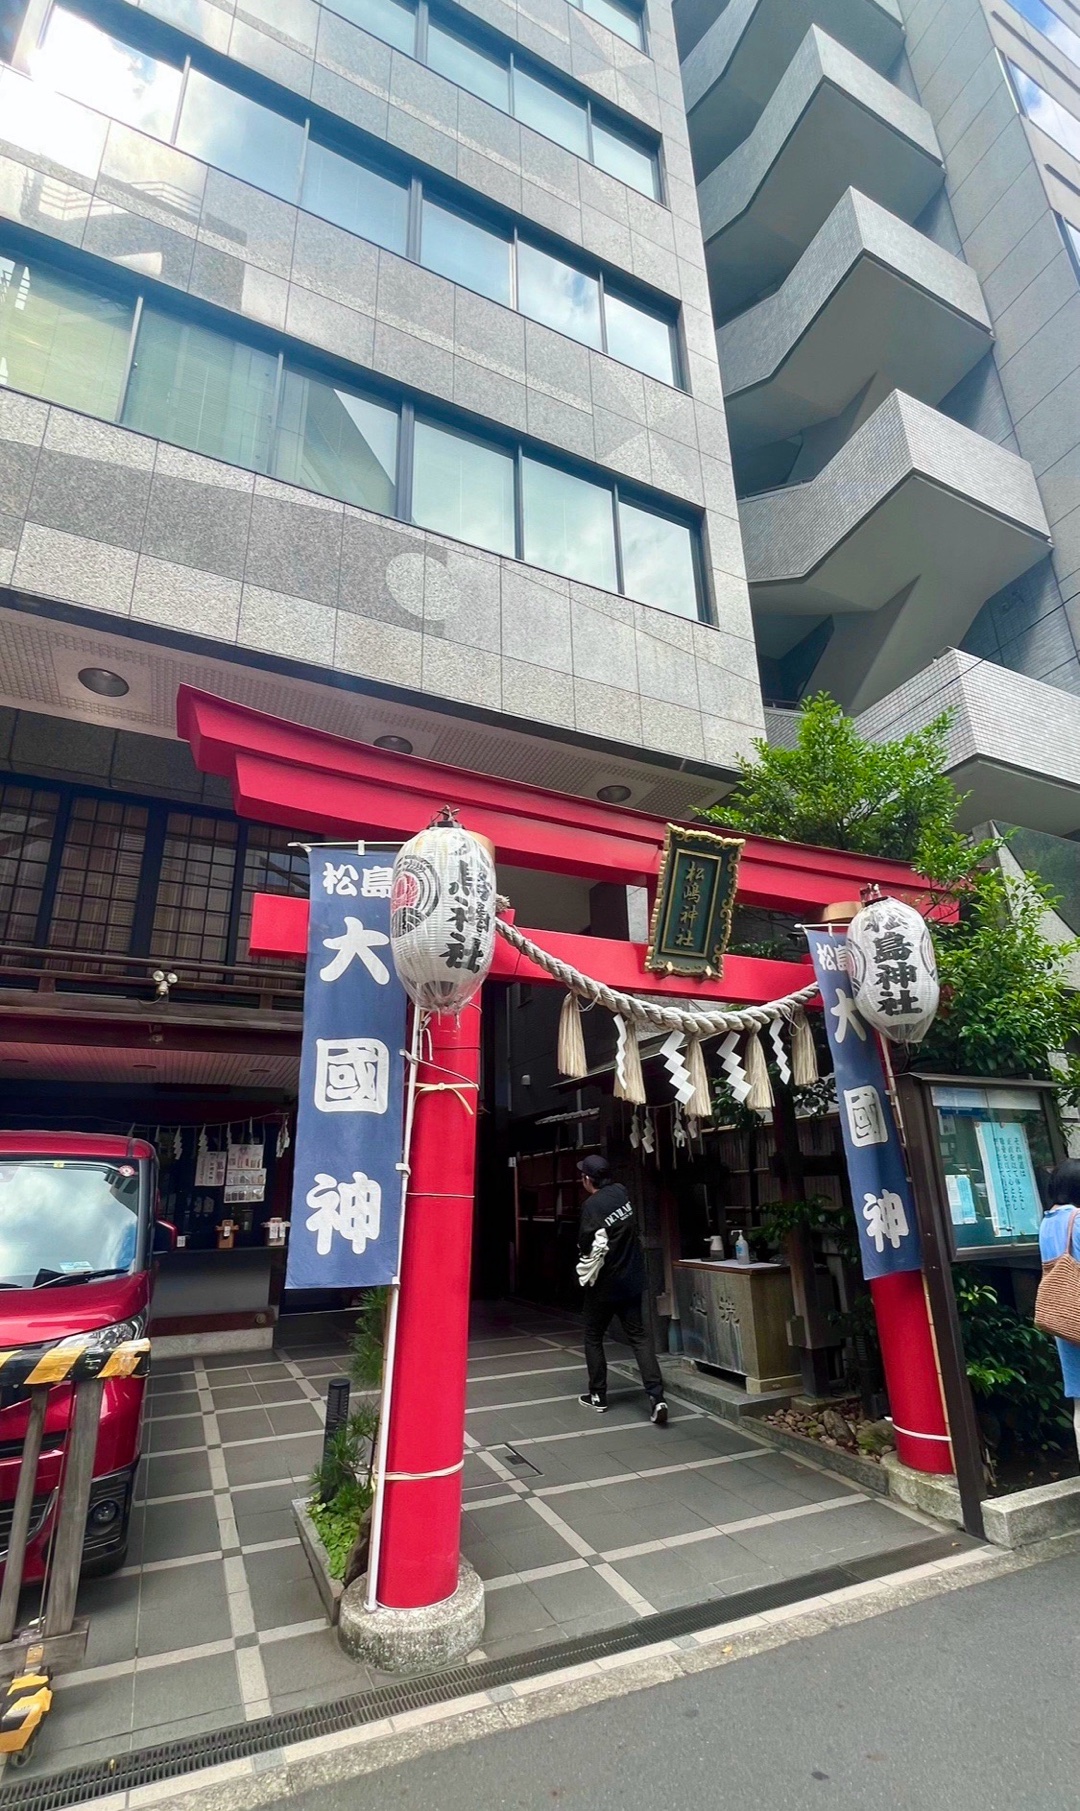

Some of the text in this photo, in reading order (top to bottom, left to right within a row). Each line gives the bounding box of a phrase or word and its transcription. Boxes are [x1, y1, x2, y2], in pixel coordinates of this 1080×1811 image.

[323, 862, 393, 898] 松島
[675, 861, 705, 947] 松嶋神社
[864, 909, 923, 1016] 松島神社
